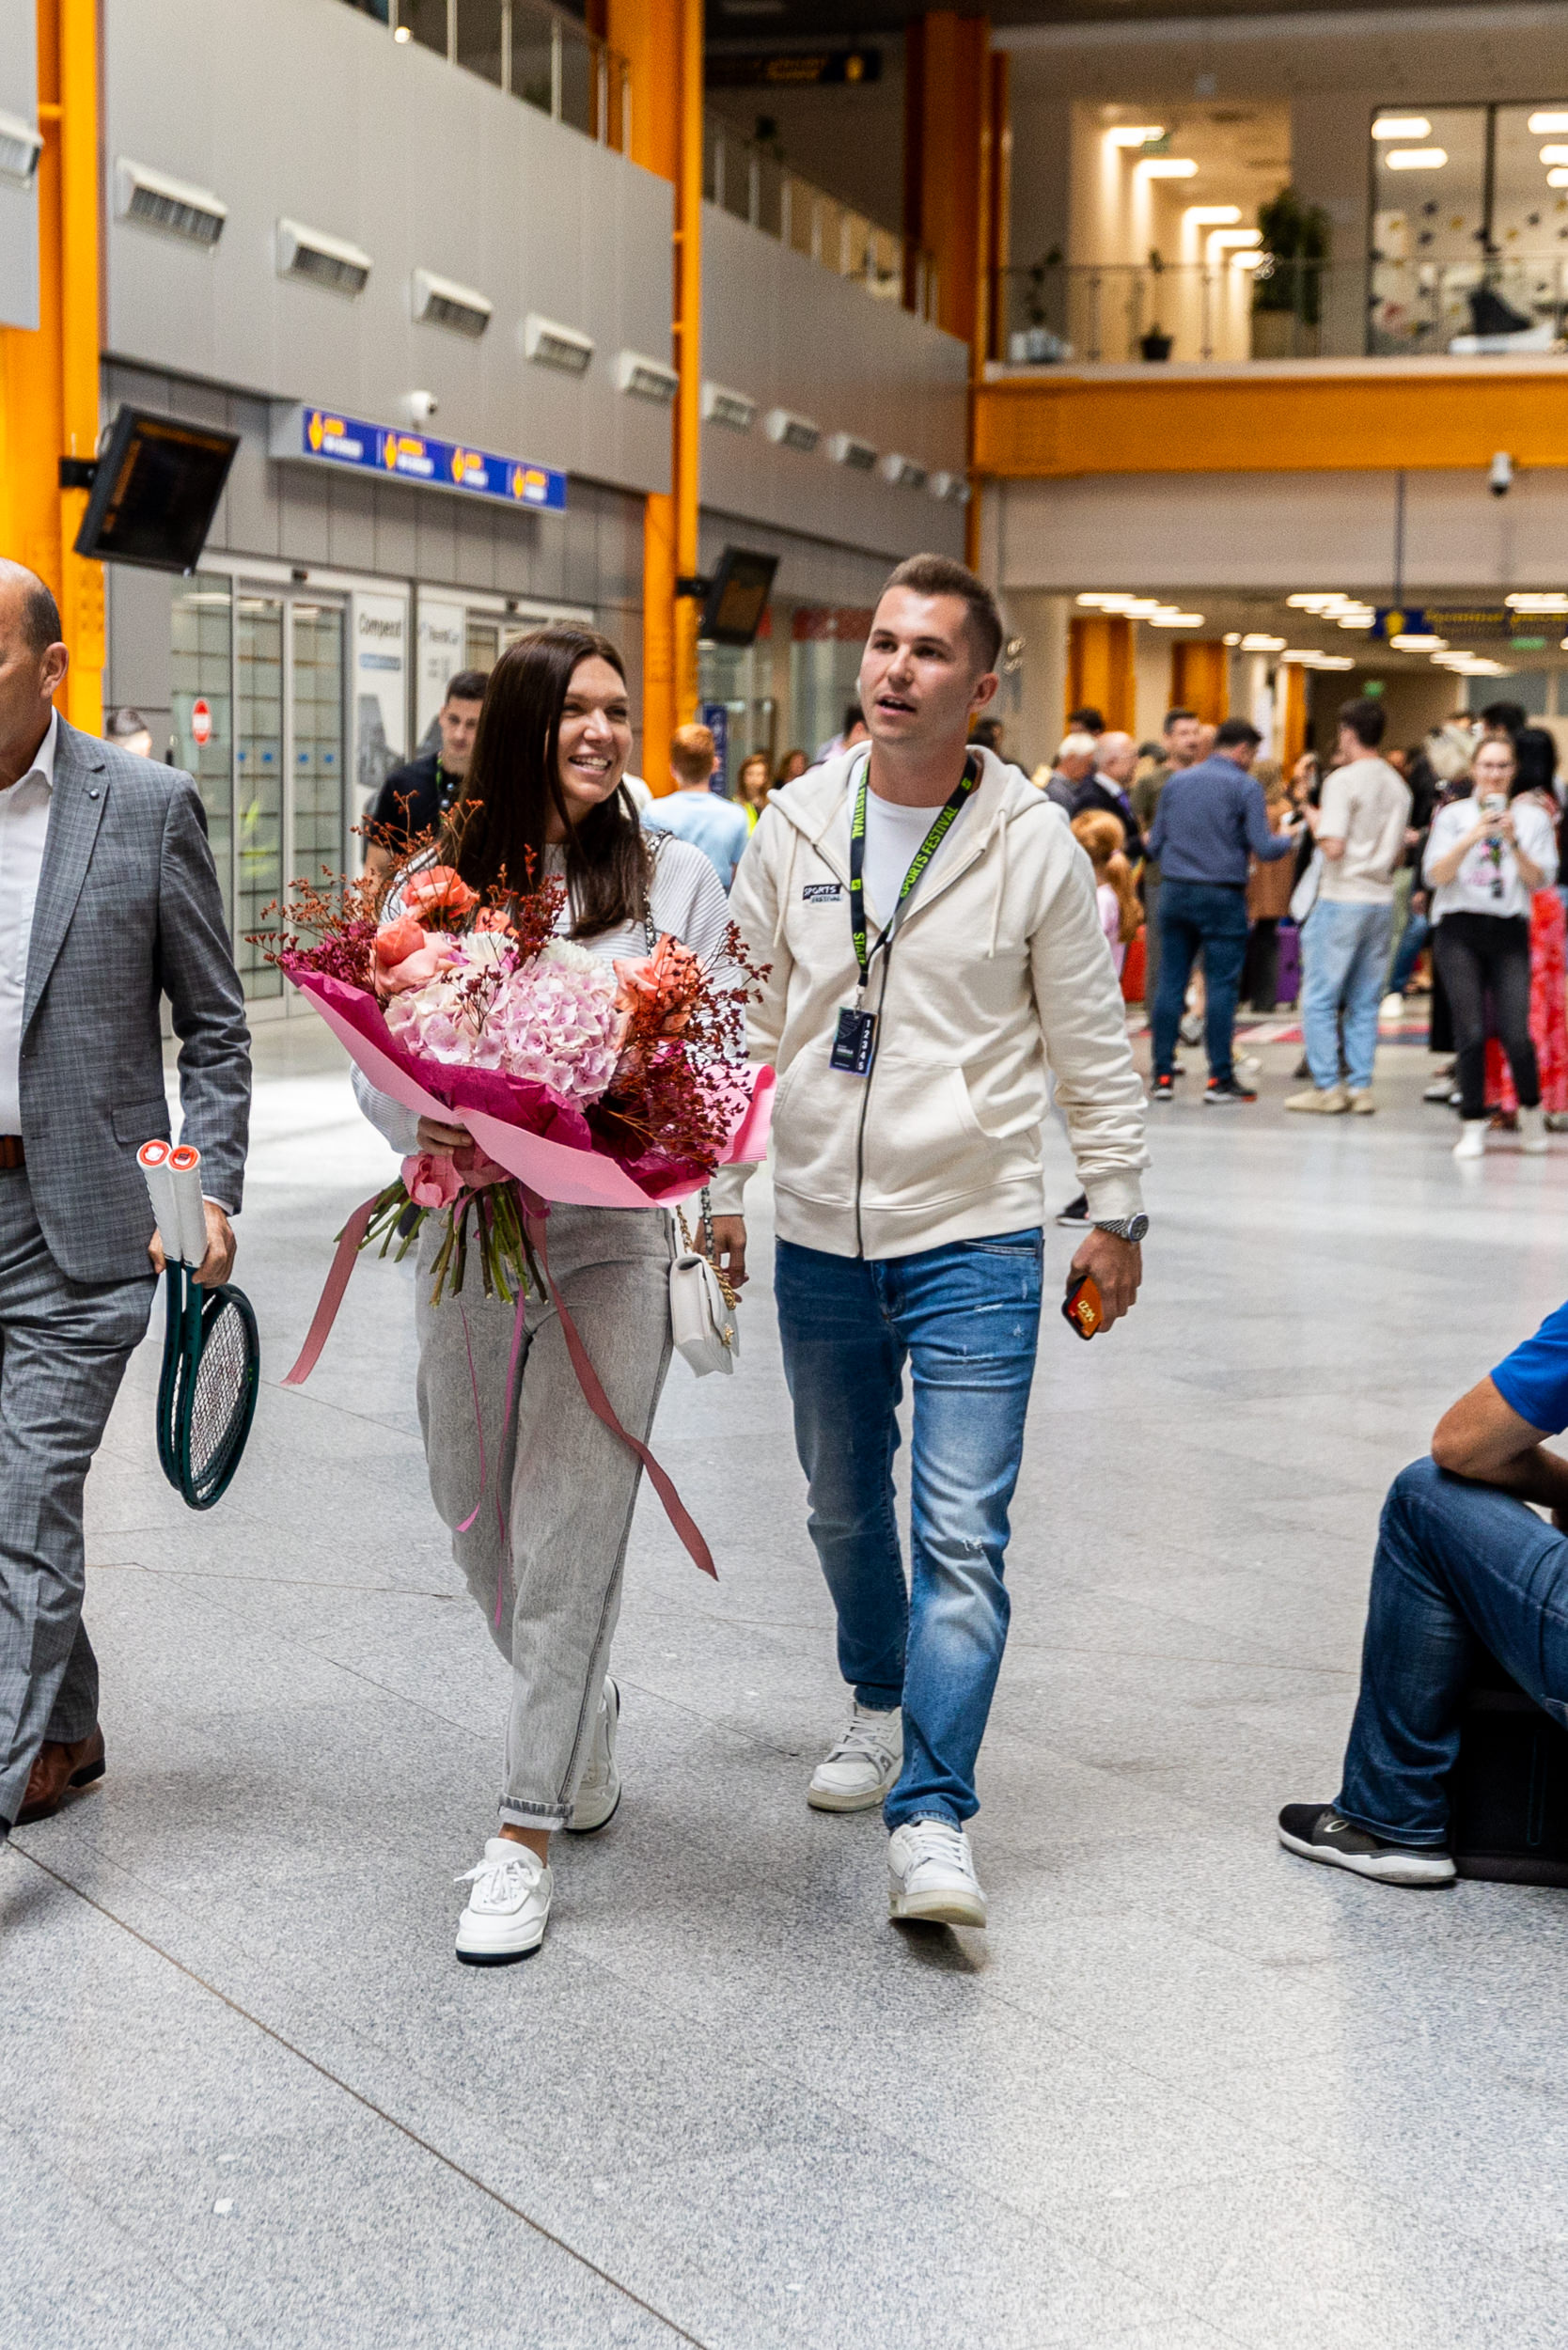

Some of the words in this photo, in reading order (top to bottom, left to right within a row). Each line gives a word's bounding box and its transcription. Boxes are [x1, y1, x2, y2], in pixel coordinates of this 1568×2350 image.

[852, 788, 865, 839] FESTIVAL
[900, 854, 929, 898] SPORTS
[920, 806, 959, 855] FESTIVAL
[804, 885, 837, 897] SPORTS
